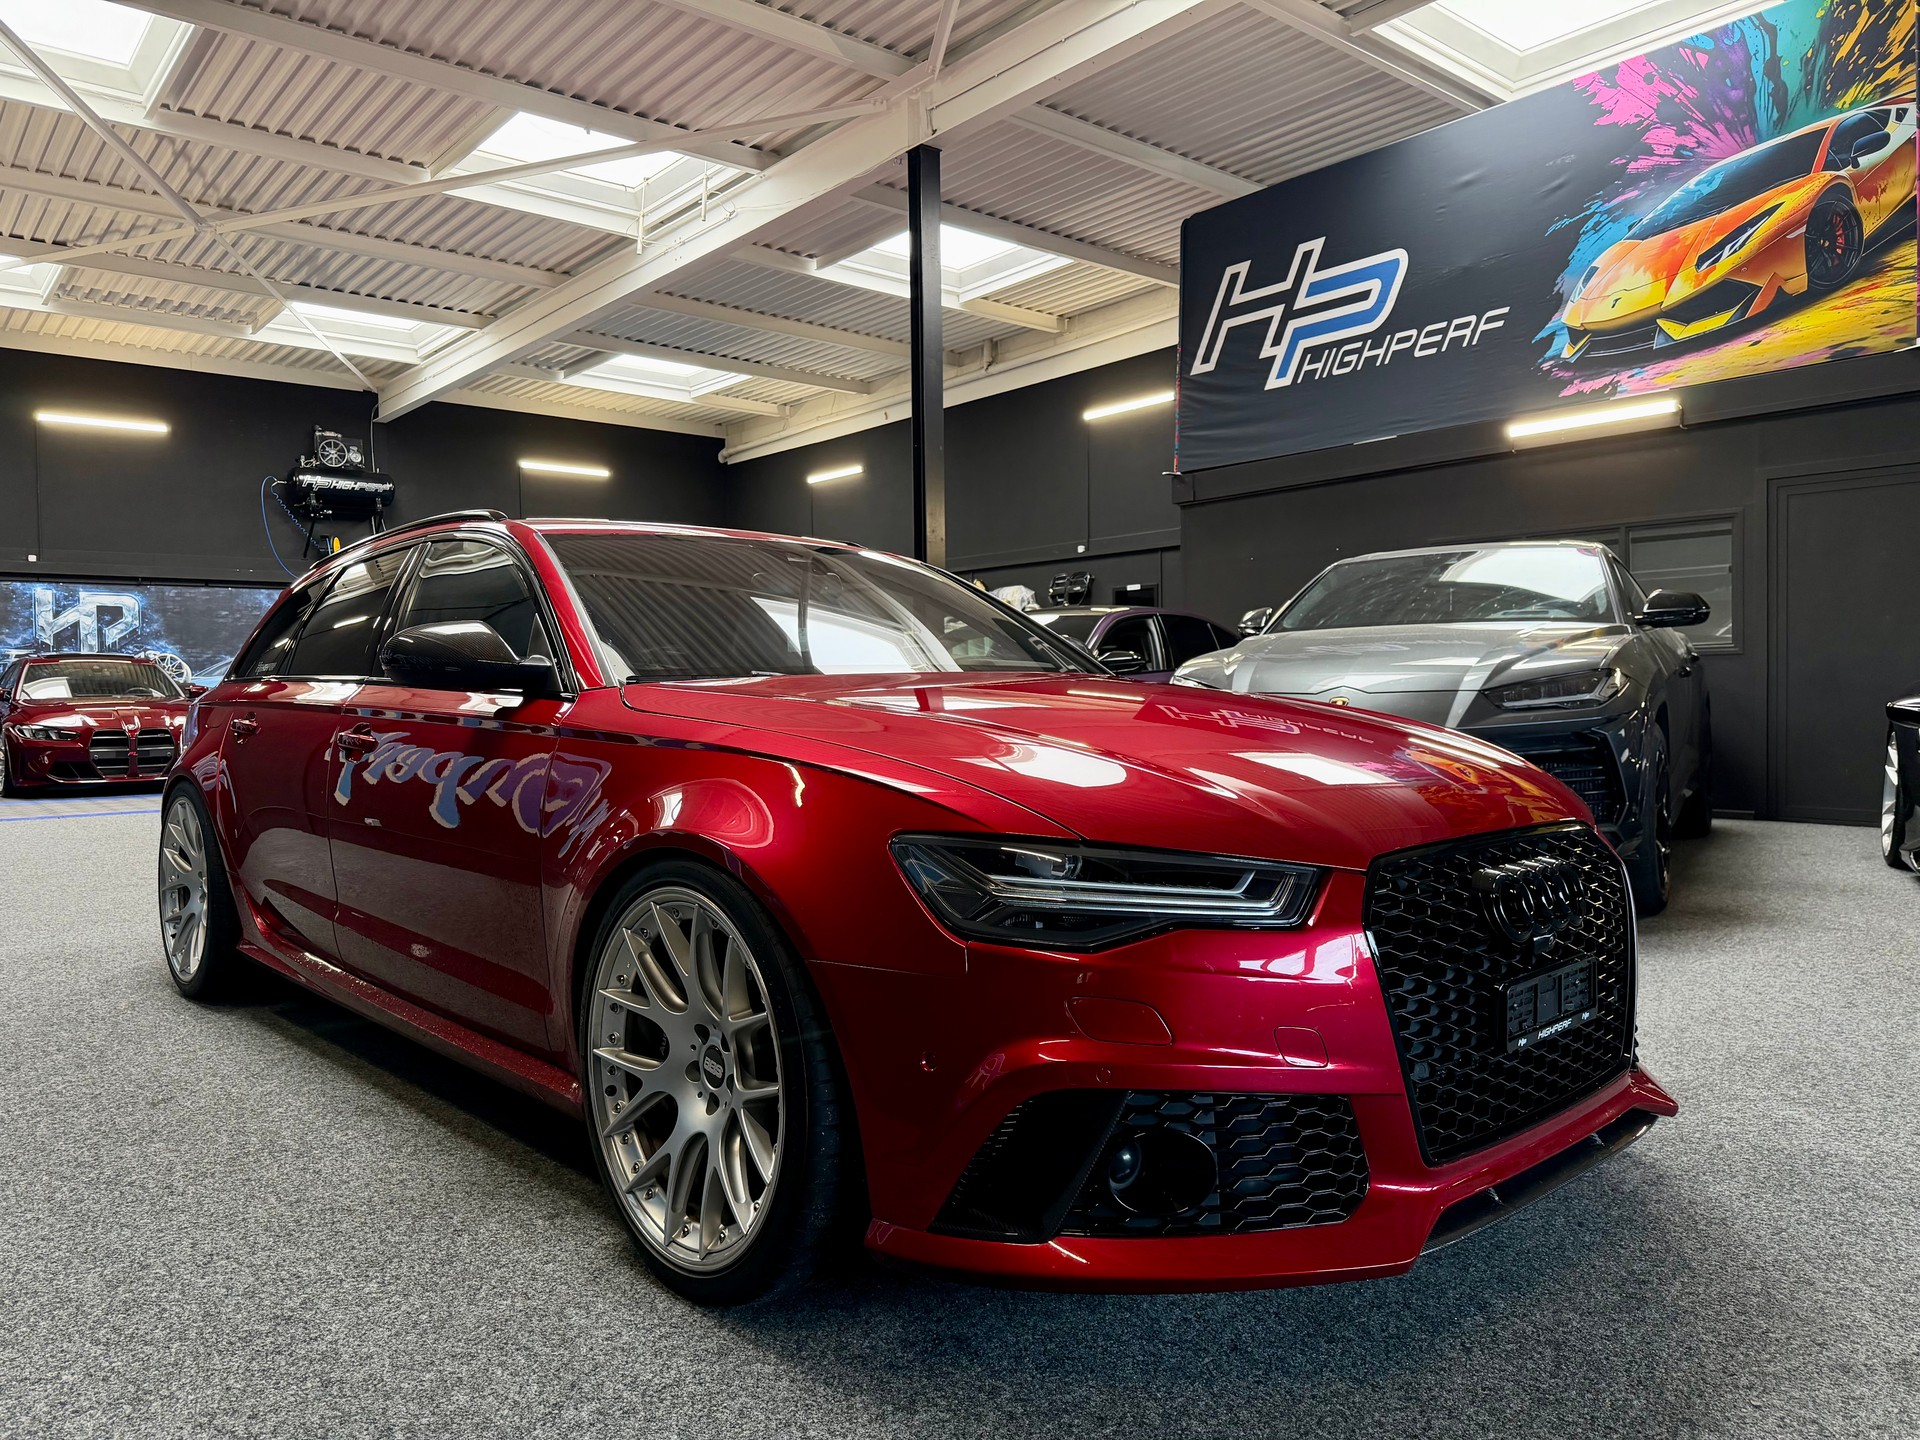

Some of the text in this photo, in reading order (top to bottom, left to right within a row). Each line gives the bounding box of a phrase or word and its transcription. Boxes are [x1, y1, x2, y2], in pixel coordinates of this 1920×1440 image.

[1297, 306, 1510, 384] HIGHPERF
[1537, 1018, 1573, 1040] HIGHPERF
[703, 1056, 724, 1079] BBS
